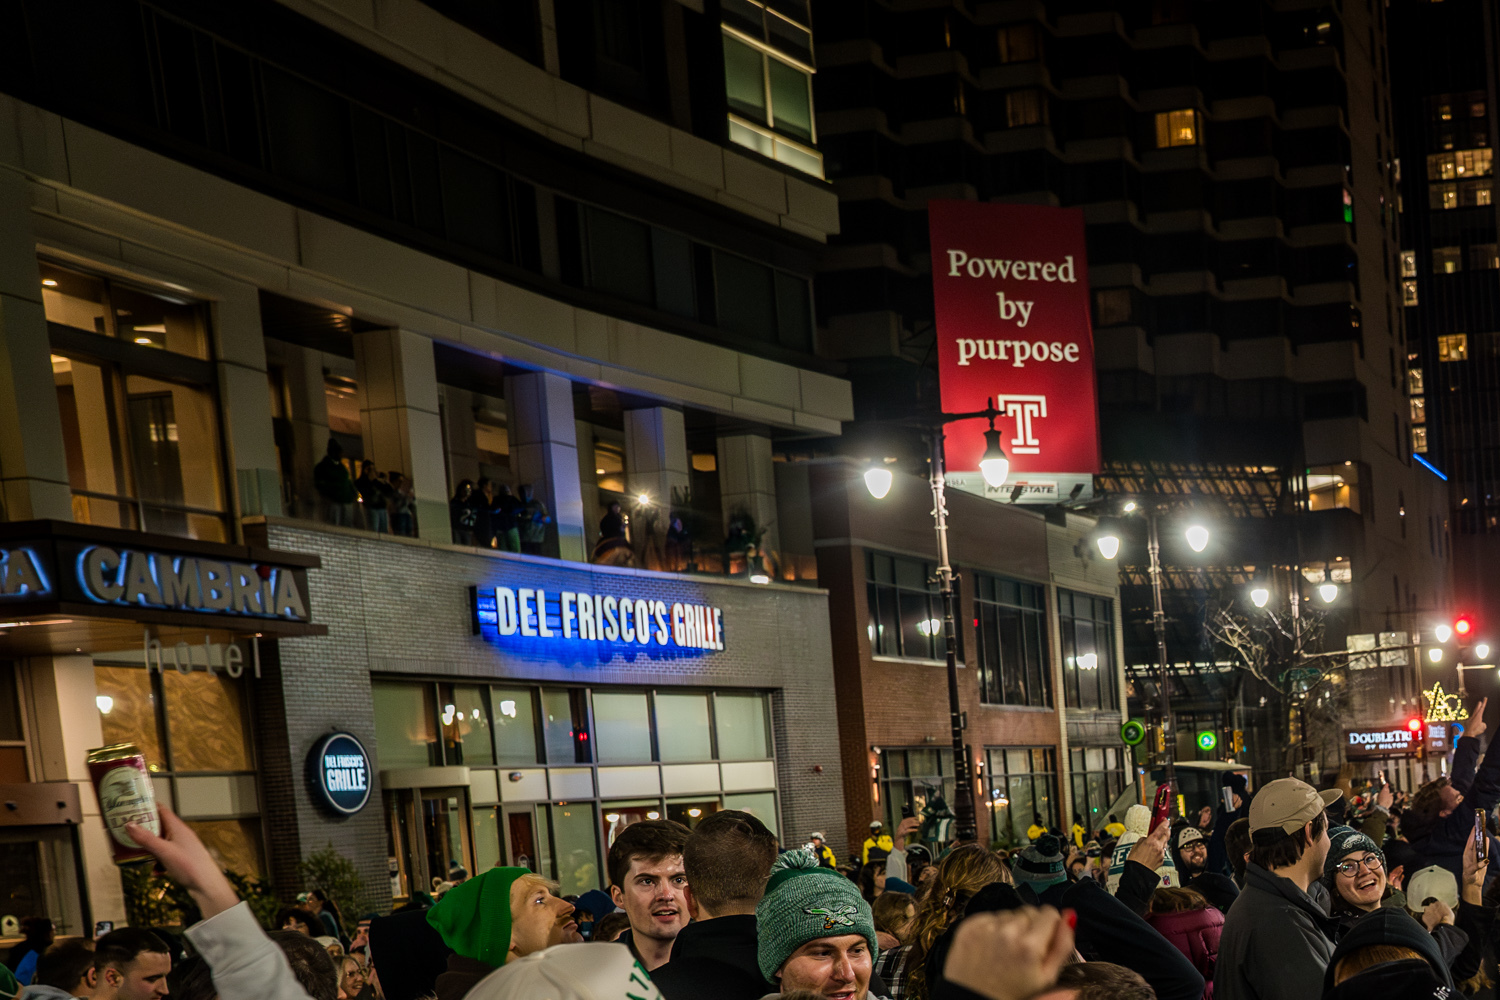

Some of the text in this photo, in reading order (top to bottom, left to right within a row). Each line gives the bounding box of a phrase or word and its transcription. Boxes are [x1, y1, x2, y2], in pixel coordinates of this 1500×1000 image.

[947, 249, 1077, 283] Powered
[996, 292, 1034, 328] by
[956, 338, 1079, 368] purpose
[997, 394, 1047, 454] T
[987, 485, 1055, 494] INTESTATE
[496, 586, 724, 650] DEL FRISCO'S GRILLE
[144, 629, 261, 679] hotel
[327, 768, 367, 791] GRILLE
